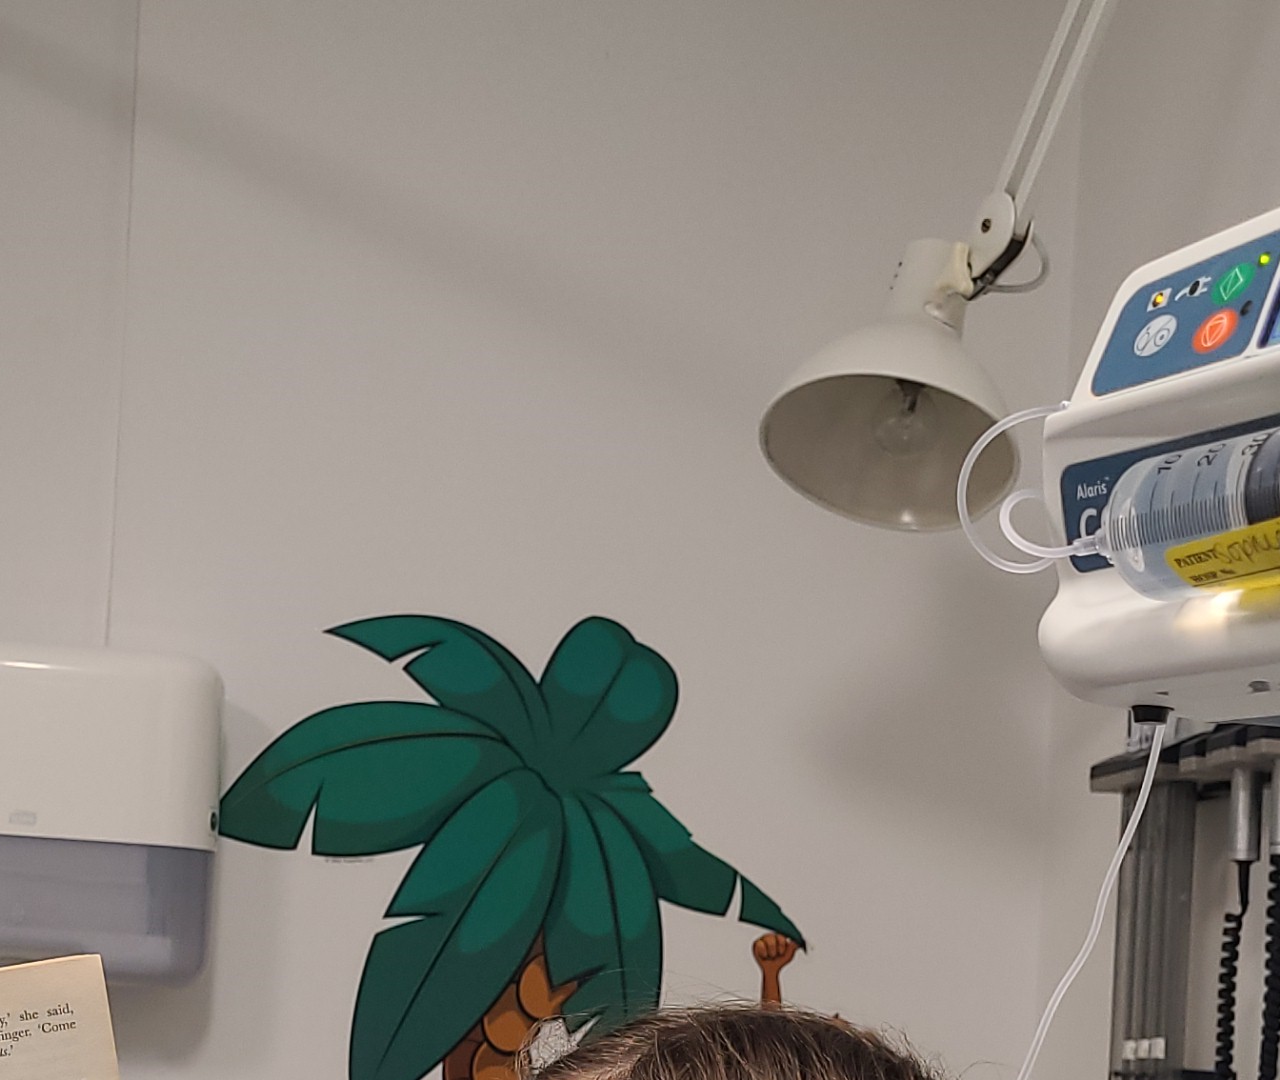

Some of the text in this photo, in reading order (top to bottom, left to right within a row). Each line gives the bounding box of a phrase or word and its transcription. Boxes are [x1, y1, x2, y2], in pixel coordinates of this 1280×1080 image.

[1197, 442, 1226, 467] 20
[1241, 432, 1272, 456] 30
[1158, 454, 1183, 475] 10
[18, 1007, 39, 1021] she
[45, 1002, 73, 1018] said,
